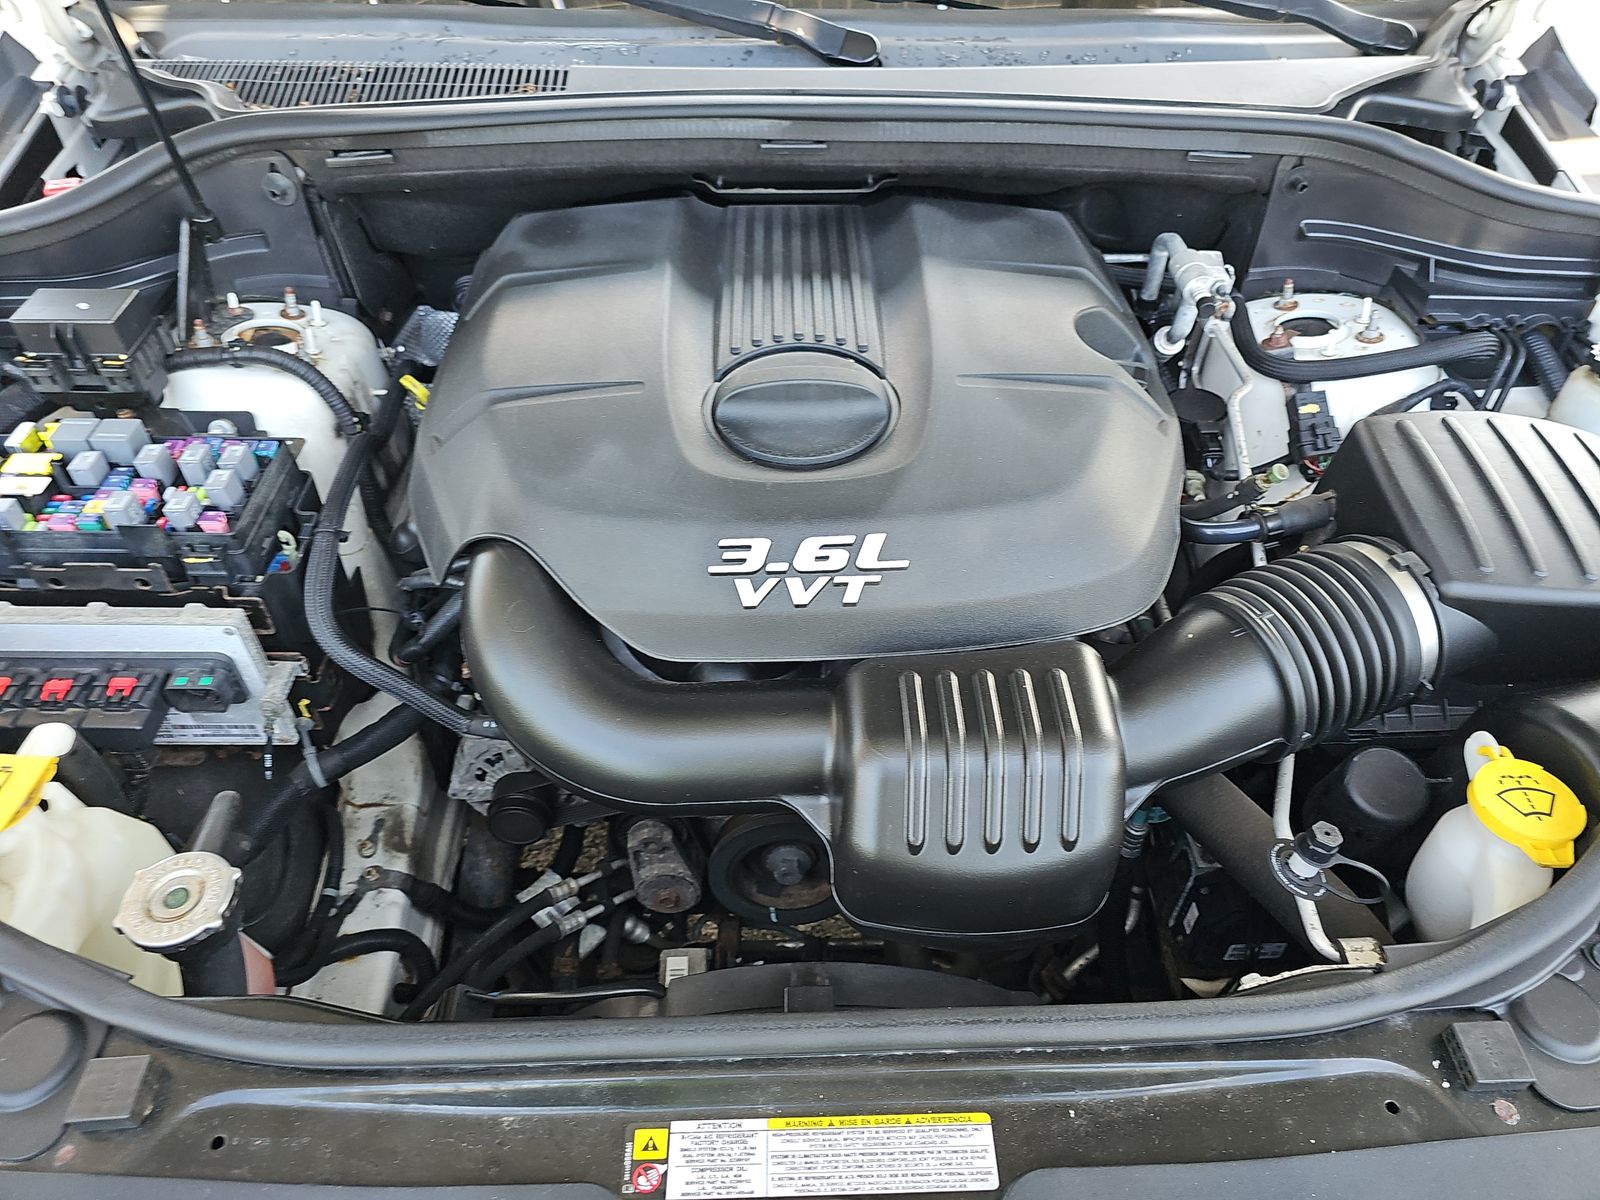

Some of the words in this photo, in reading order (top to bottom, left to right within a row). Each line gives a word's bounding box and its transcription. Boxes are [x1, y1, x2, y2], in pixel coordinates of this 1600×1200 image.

[707, 532, 911, 576] 3.6L
[733, 574, 883, 609] VVT
[696, 1121, 743, 1130] ATTENTION
[784, 1119, 824, 1128] WARNING
[838, 1118, 858, 1126] MISE
[860, 1118, 872, 1126] EN
[915, 1115, 973, 1124] ADVERTENCIA
